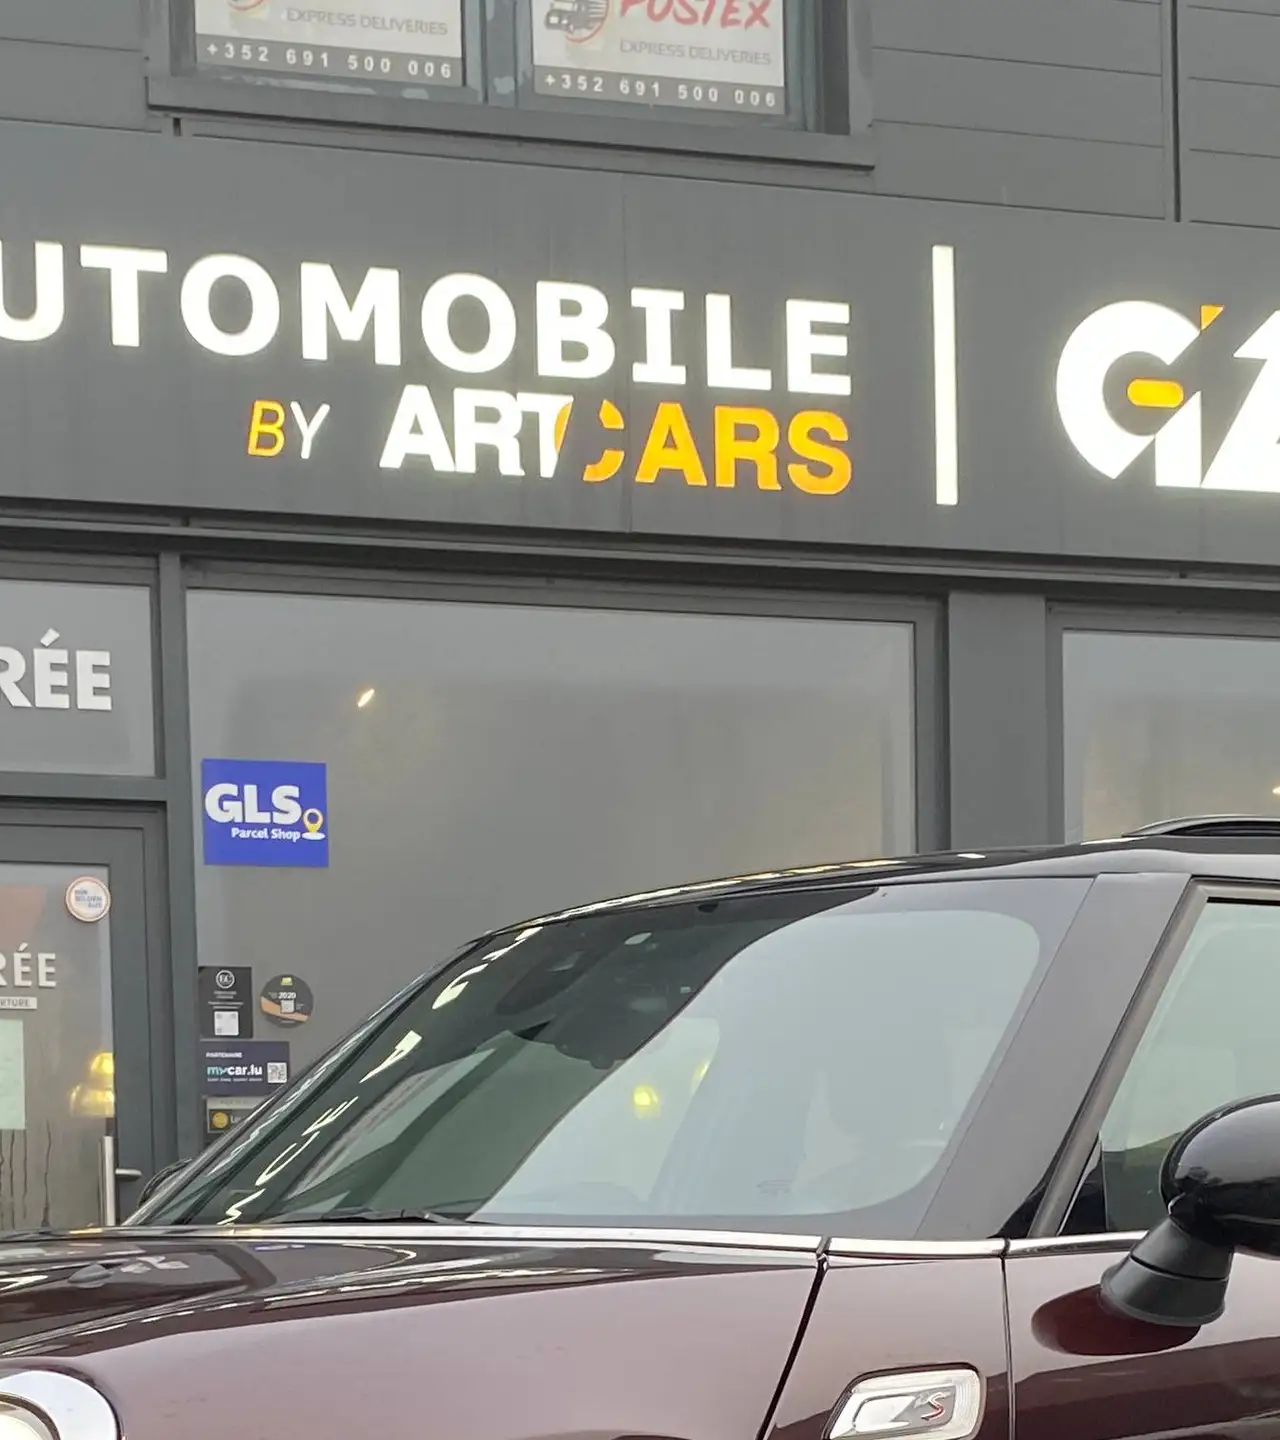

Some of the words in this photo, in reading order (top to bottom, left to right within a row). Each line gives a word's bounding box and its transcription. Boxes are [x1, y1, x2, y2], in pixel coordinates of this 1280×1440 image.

[286, 8, 356, 27] EXPRESS
[360, 14, 448, 36] DELIVERIES
[207, 43, 269, 62] +352
[286, 51, 329, 67] 691
[347, 54, 391, 73] 500
[408, 60, 452, 79] 006
[620, 40, 685, 58] EXPRESS
[689, 46, 772, 66] DELIVERIES
[544, 74, 603, 92] +352
[620, 79, 659, 98] 691
[677, 84, 718, 102] 500
[735, 89, 776, 108] 006
[247, 400, 331, 459] BY
[205, 783, 302, 825] GLS
[231, 827, 269, 839] Parcel
[271, 828, 301, 842] Shop
